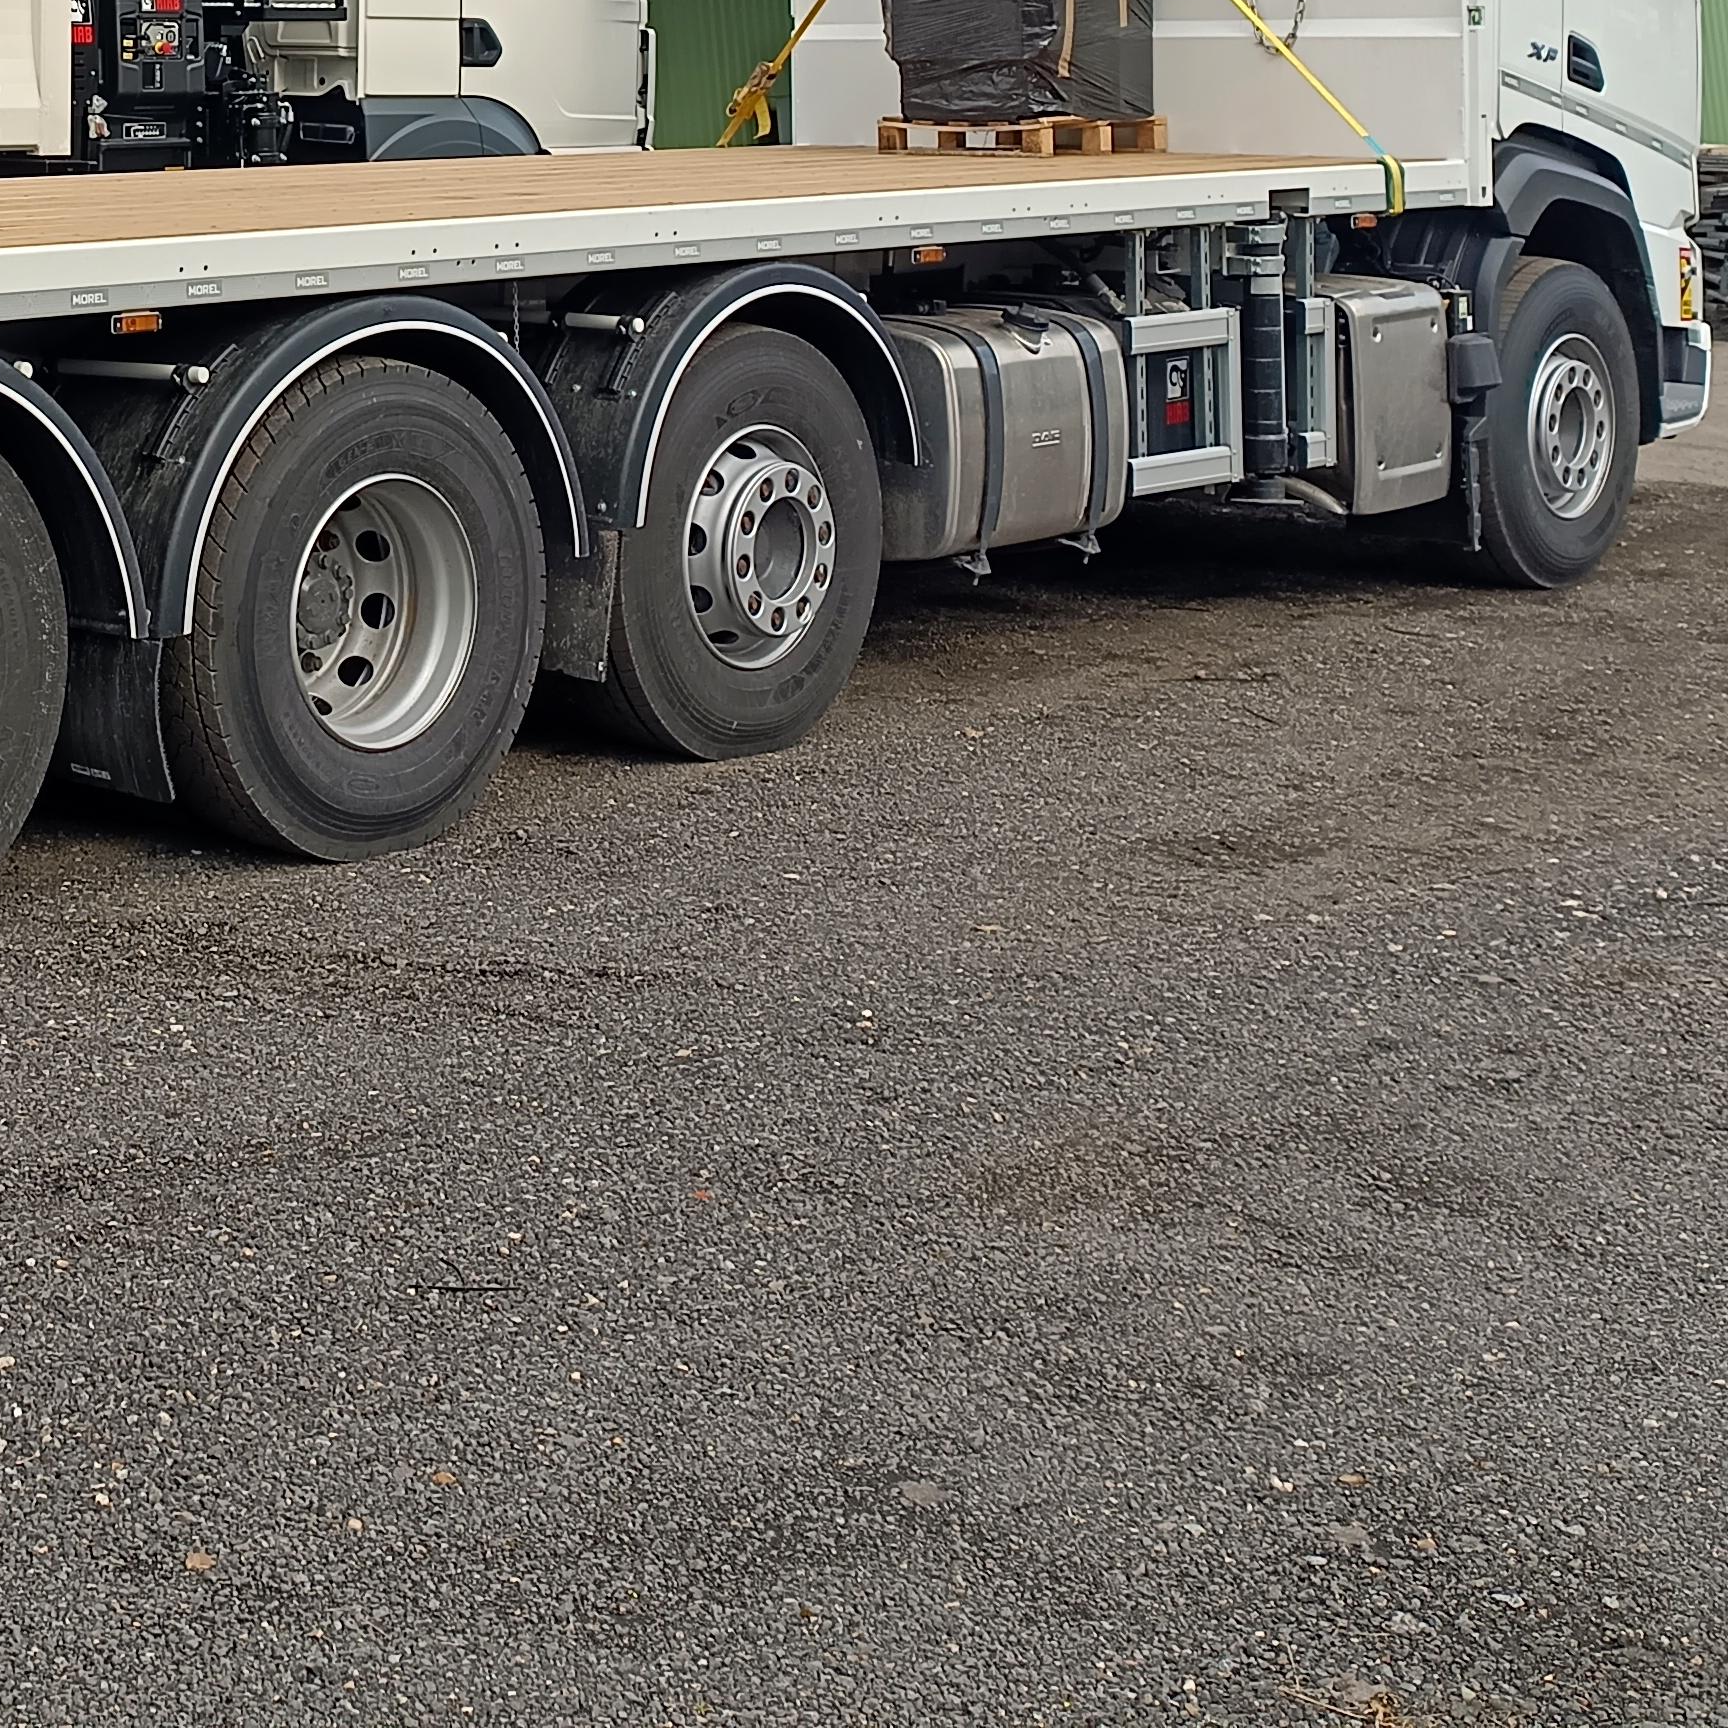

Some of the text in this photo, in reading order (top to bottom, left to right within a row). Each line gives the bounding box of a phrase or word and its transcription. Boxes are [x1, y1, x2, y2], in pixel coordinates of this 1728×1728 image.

[73, 26, 93, 43] IAB
[1527, 41, 1559, 63] XF
[757, 240, 781, 251] MOREL
[835, 234, 859, 244] MOREL
[587, 252, 615, 264] MOREL
[674, 246, 700, 257] MOREL
[496, 259, 524, 272] MOREL
[399, 267, 429, 279] MOREL
[296, 275, 328, 288] MOREL
[188, 283, 221, 296] MOREL
[72, 293, 107, 306] MOREL
[1032, 429, 1060, 445] DAF
